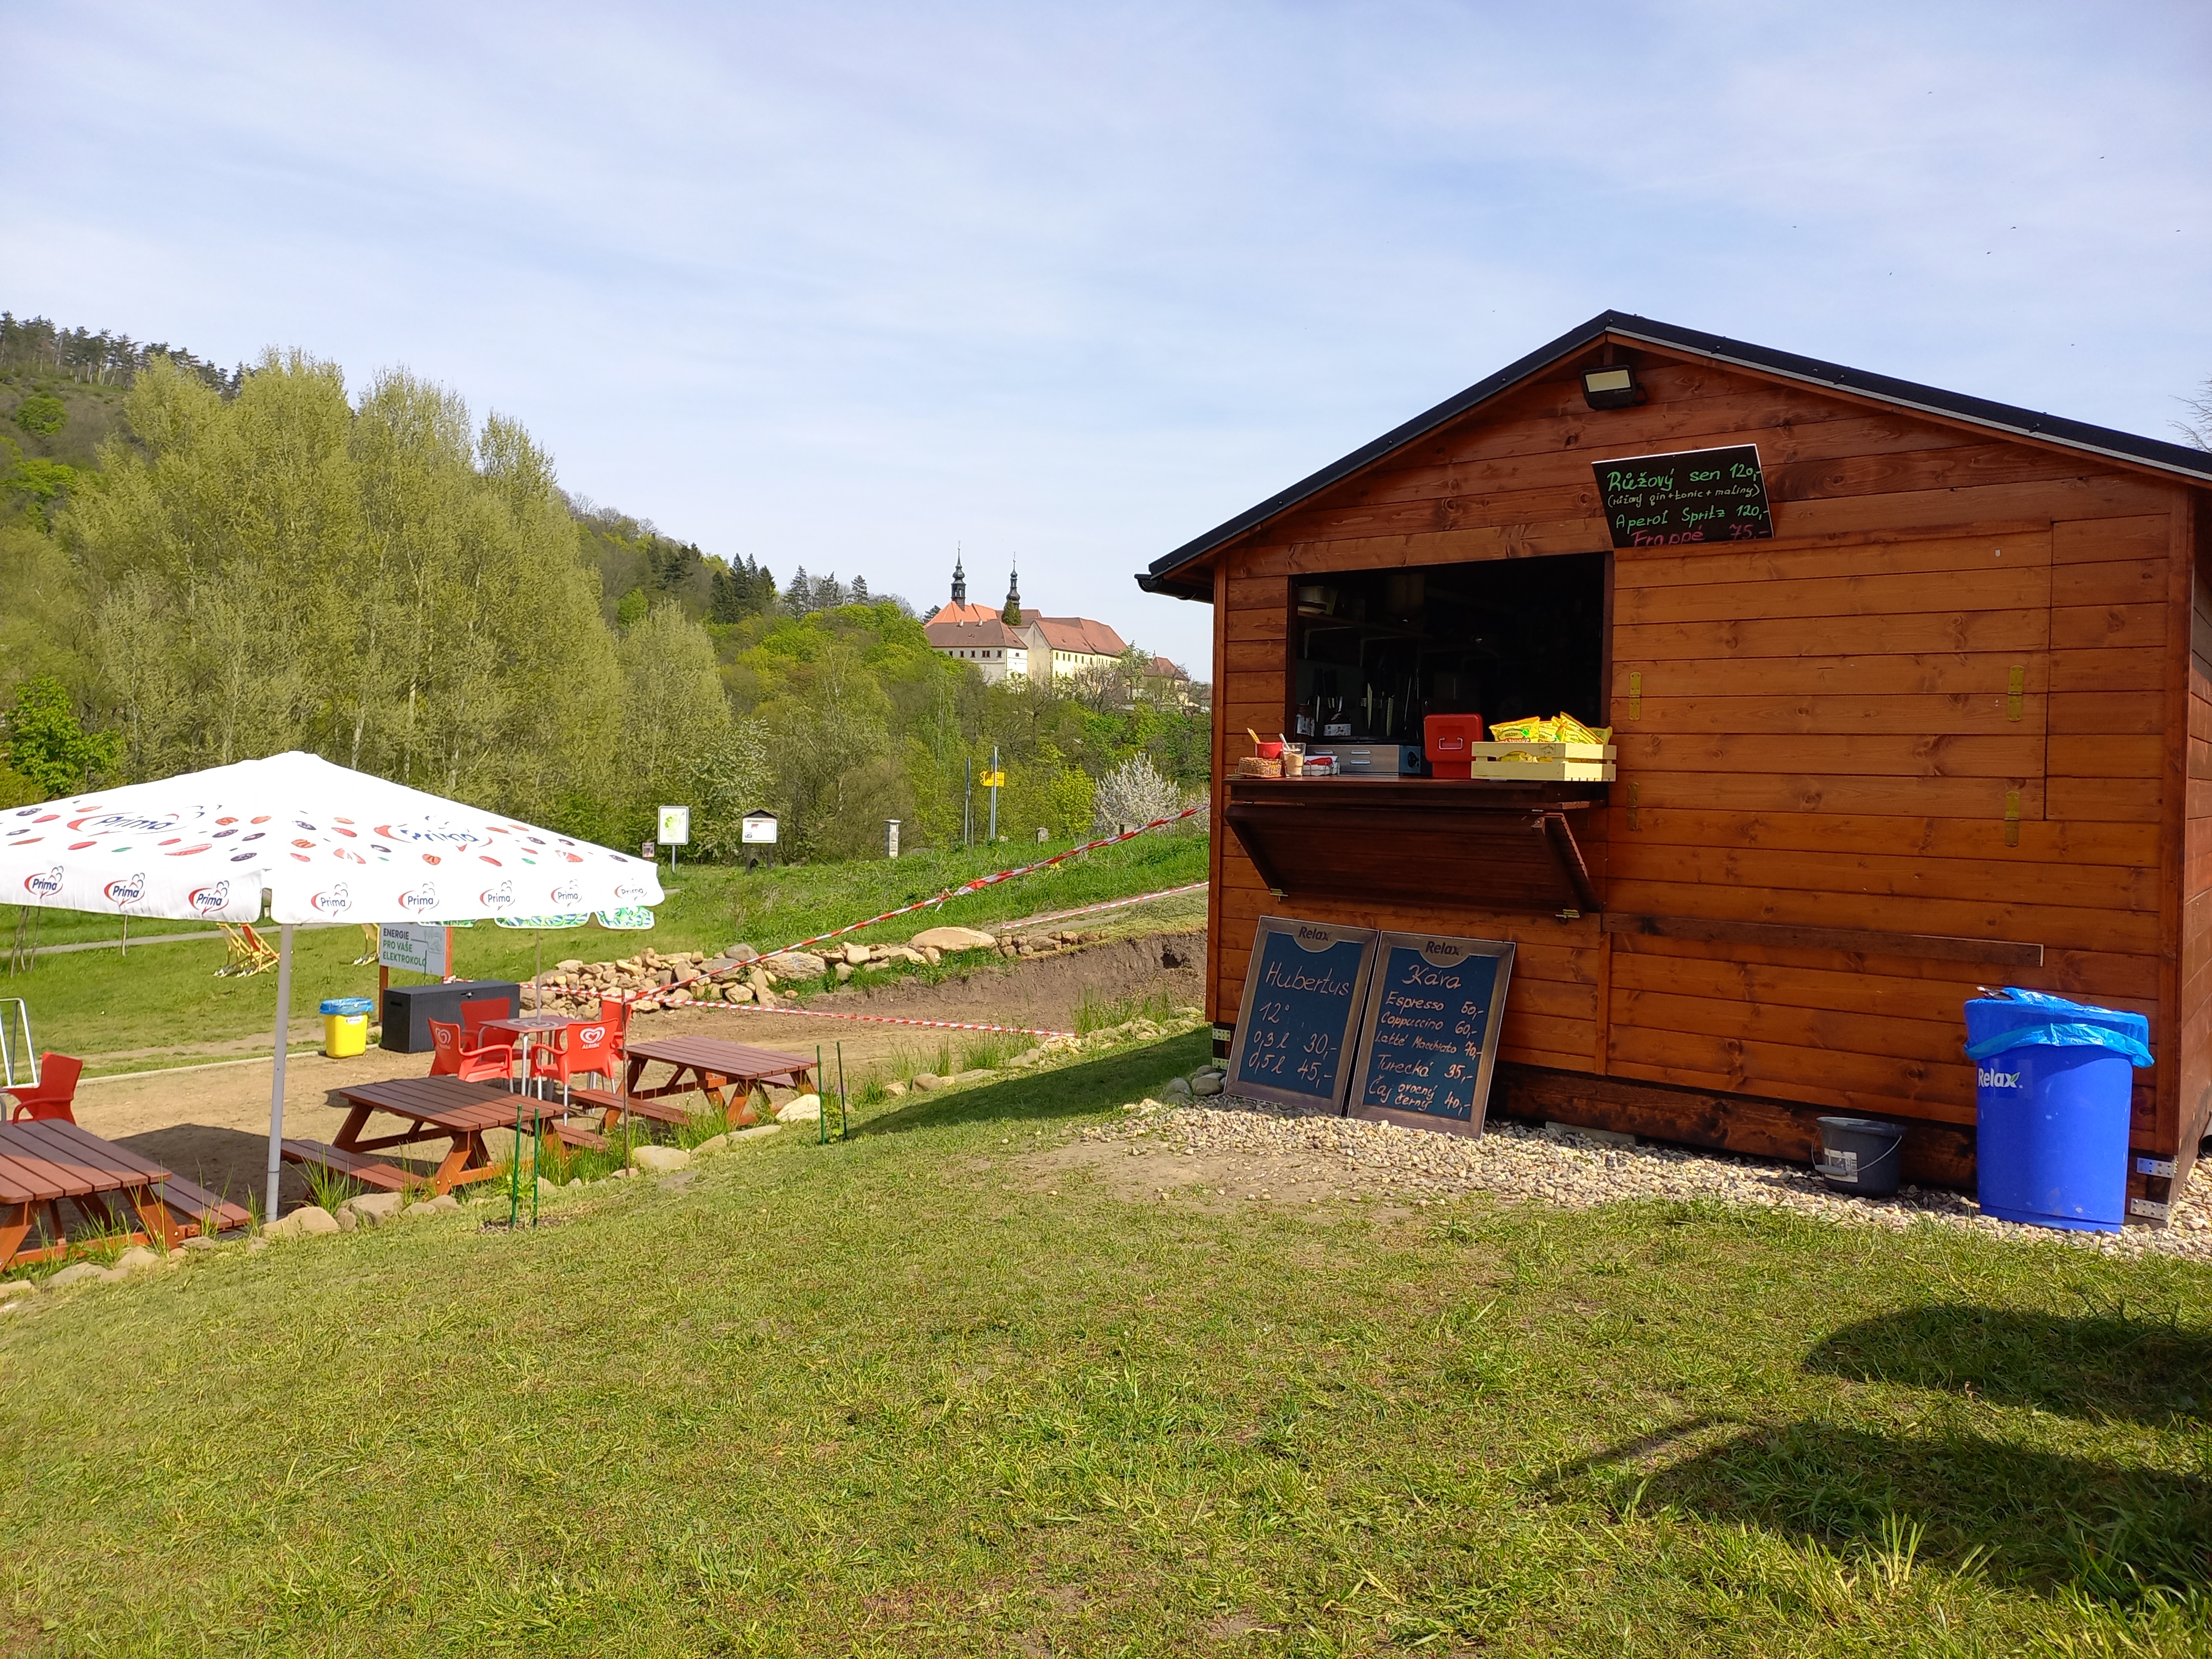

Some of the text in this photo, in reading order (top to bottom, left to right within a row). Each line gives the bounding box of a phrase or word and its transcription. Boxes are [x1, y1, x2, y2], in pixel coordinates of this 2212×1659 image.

[1689, 469, 1721, 482] sen
[1616, 509, 1669, 535] Aperol
[1681, 504, 1726, 528] Spritz
[32, 878, 58, 891] Prima
[112, 885, 139, 899] Prima
[488, 893, 510, 902] Prima
[558, 891, 578, 900] Prima
[196, 893, 222, 907] Prima
[320, 896, 346, 907] Prima
[408, 895, 434, 905] Prima
[383, 927, 410, 941] ENERGIE
[1298, 926, 1333, 942] Relax
[383, 940, 413, 953] PRO VAŠE
[1425, 940, 1464, 956] Relax
[1265, 961, 1350, 996] Hubertus
[1385, 990, 1444, 1015] Espresso
[1381, 1011, 1444, 1030] Cappuccino
[1377, 1054, 1435, 1077] Turecká
[1978, 1067, 2021, 1088] Relax
